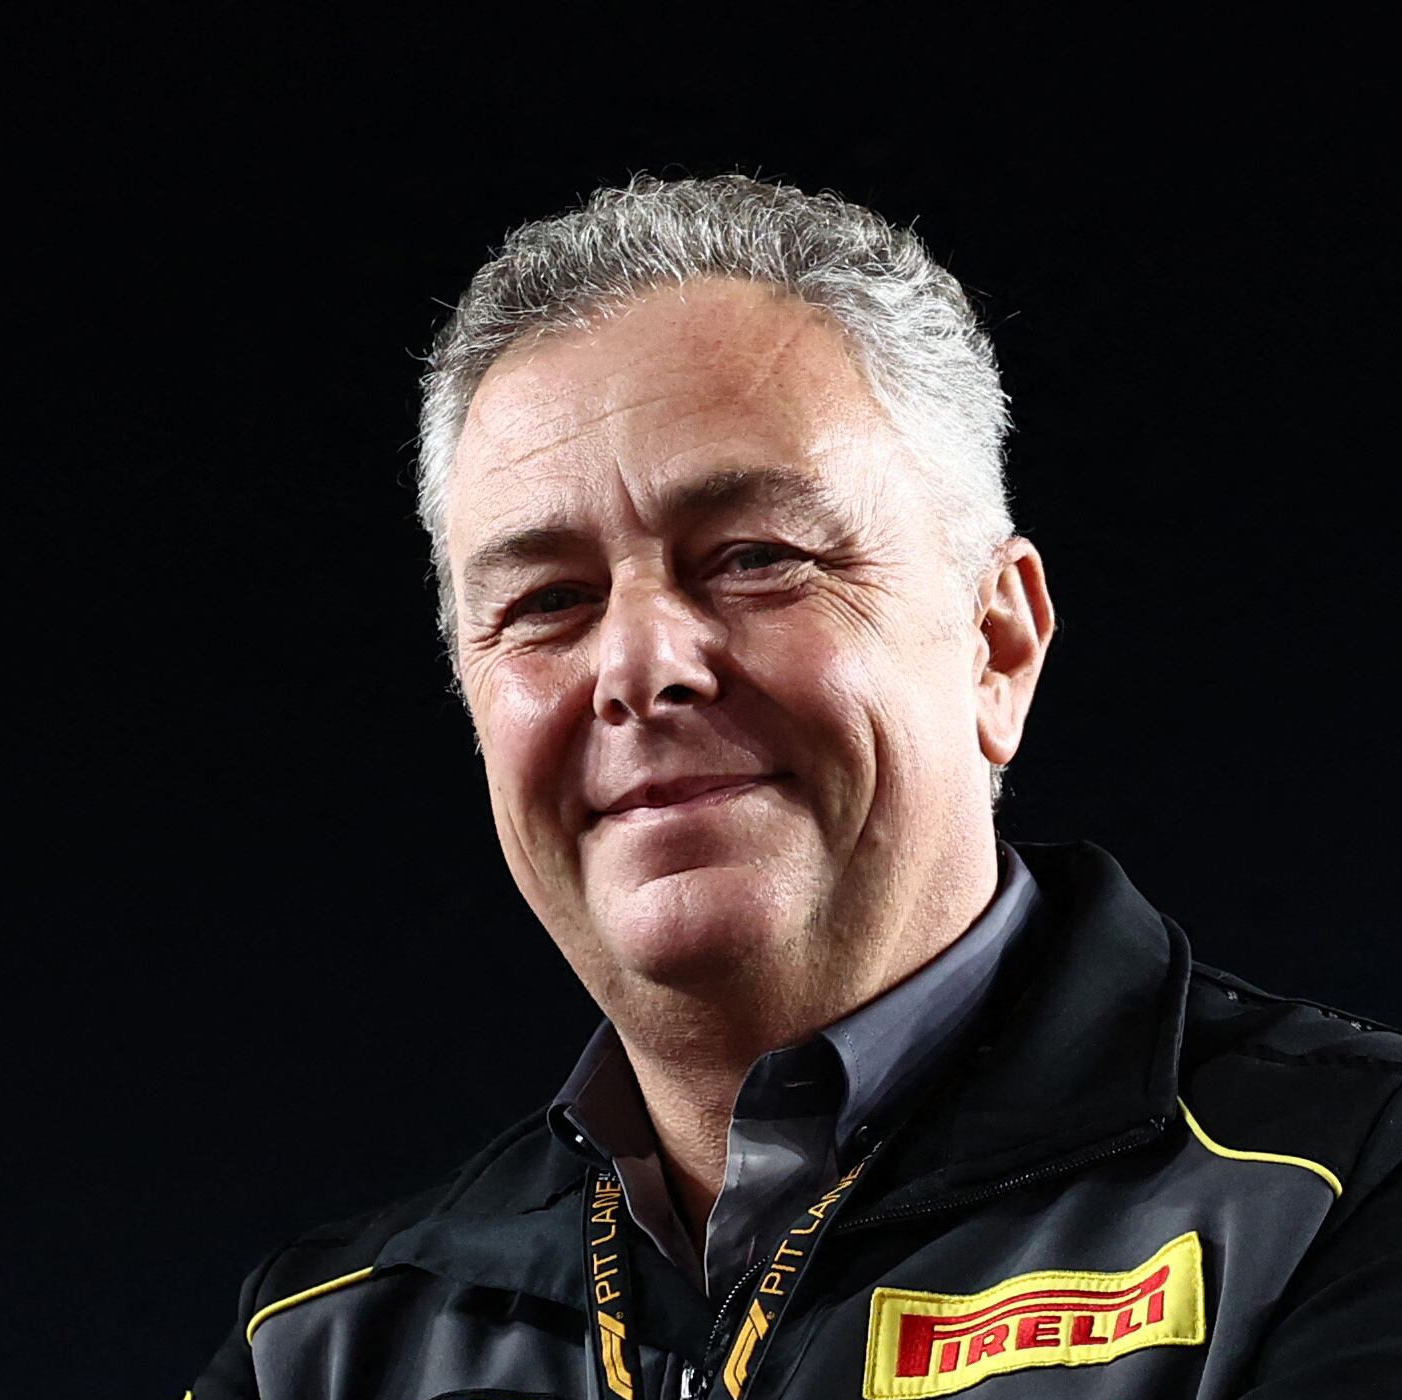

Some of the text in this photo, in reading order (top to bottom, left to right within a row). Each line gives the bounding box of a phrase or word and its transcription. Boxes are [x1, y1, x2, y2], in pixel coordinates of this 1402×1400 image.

[591, 1180, 622, 1247] LANE
[759, 1239, 804, 1296] PIT
[790, 1161, 866, 1235] LANE
[592, 1252, 621, 1305] PIT
[895, 1264, 1170, 1378] PIRELLI
